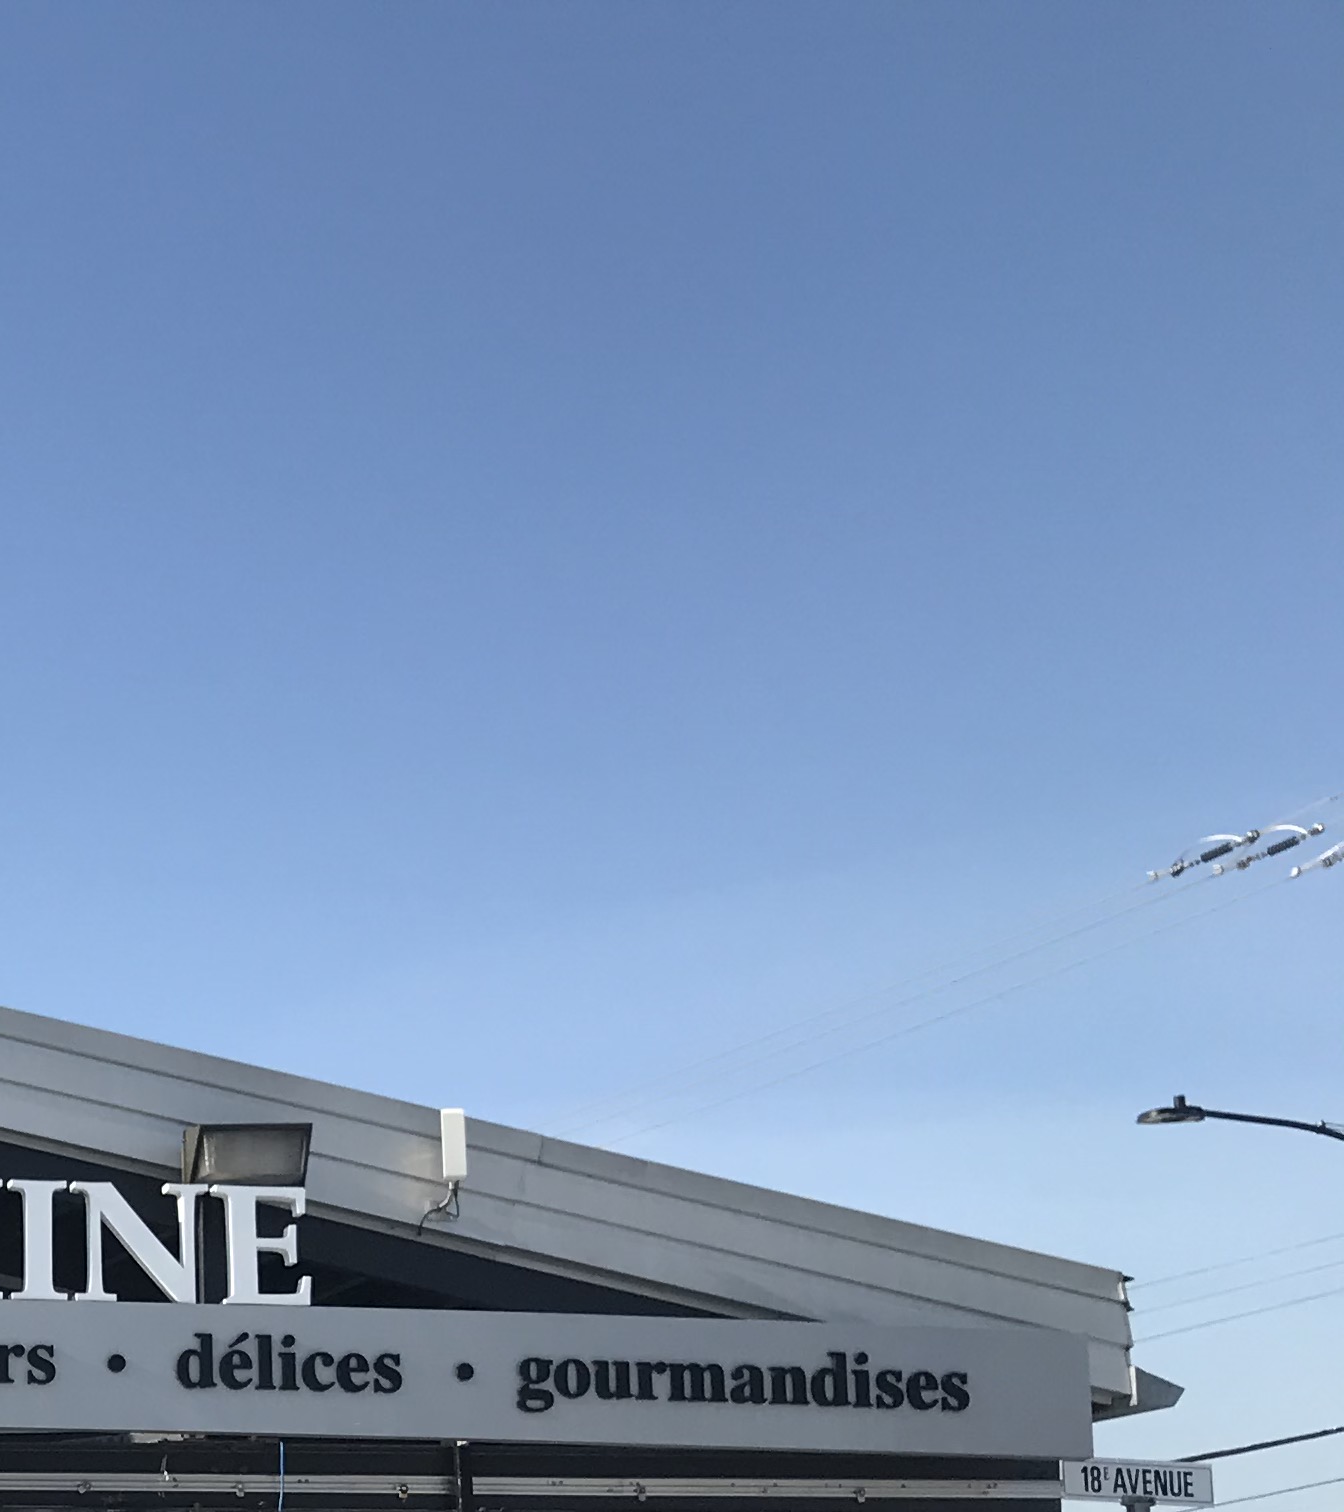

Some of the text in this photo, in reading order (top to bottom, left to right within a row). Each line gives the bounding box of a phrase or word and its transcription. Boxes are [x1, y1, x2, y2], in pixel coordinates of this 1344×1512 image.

[176, 1333, 402, 1394] délices
[516, 1352, 971, 1413] gourmandises
[1113, 1467, 1194, 1497] AVENUE
